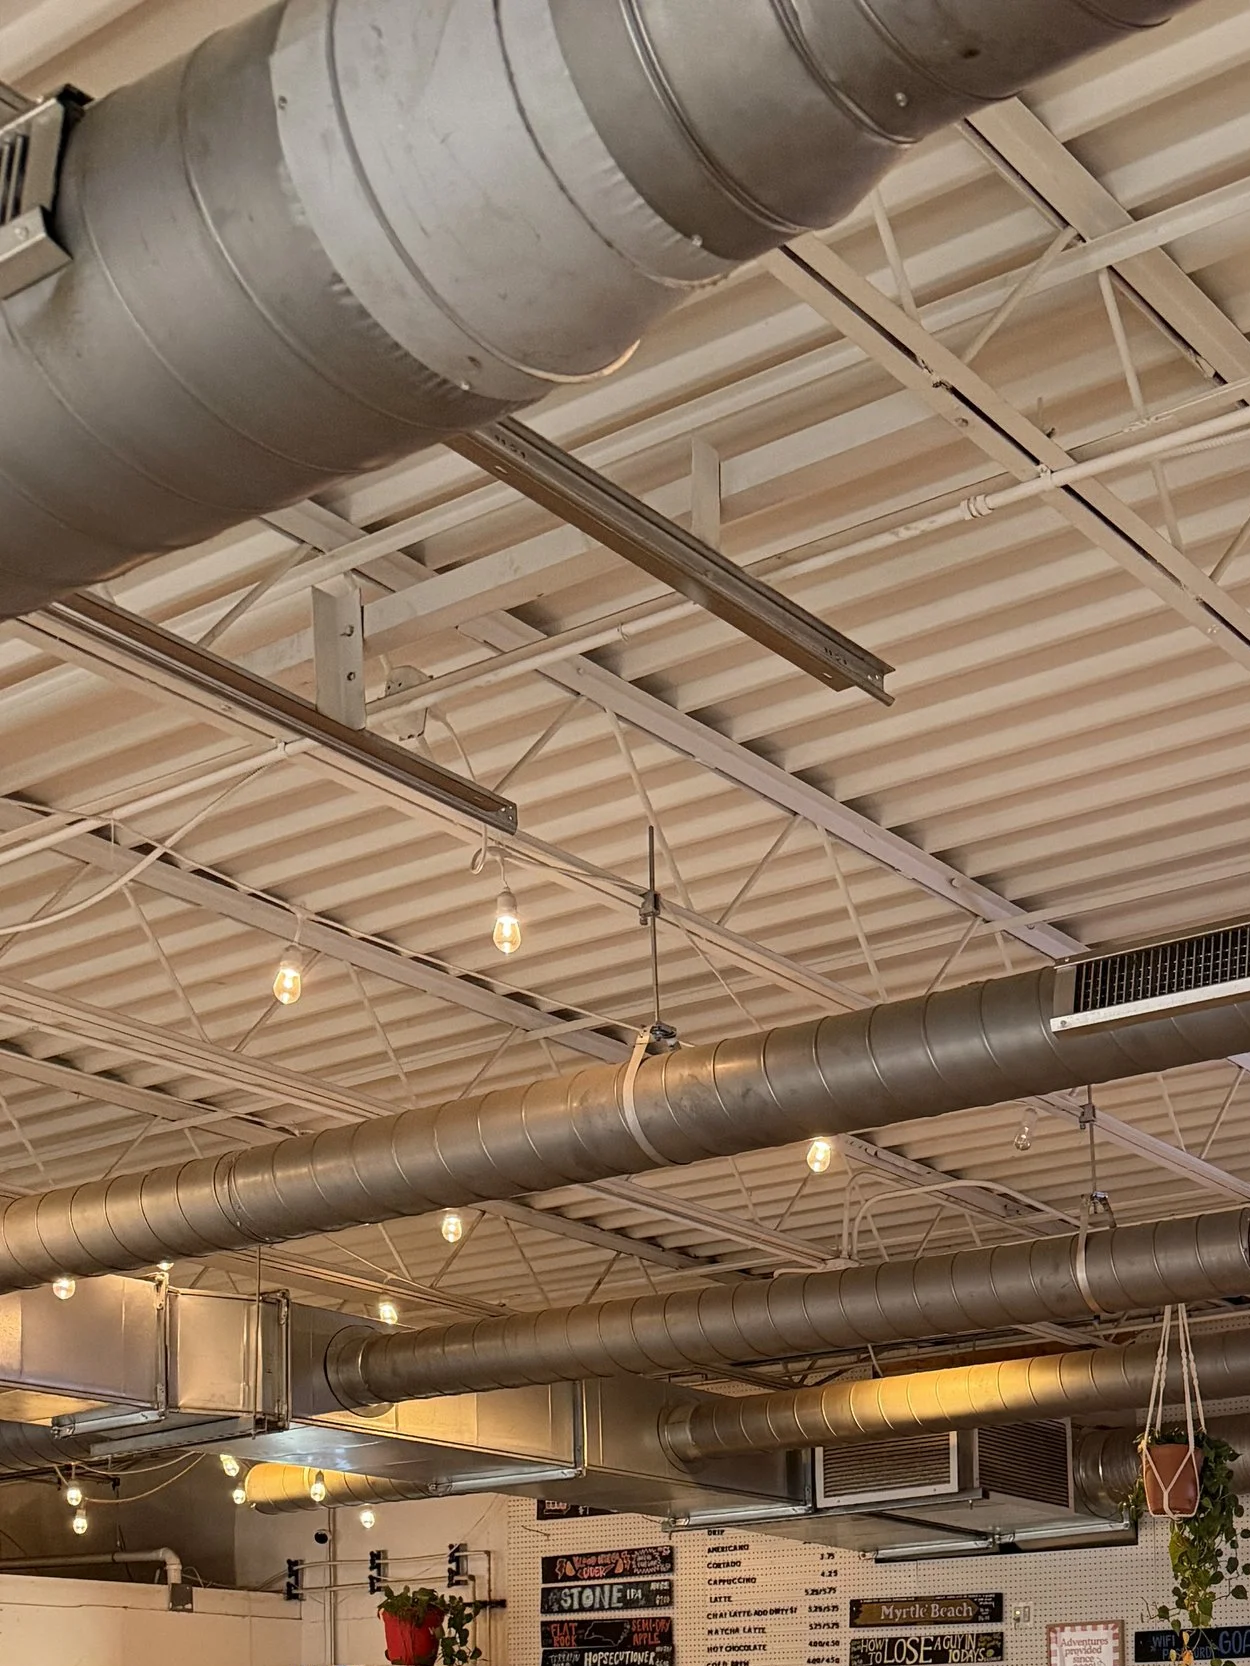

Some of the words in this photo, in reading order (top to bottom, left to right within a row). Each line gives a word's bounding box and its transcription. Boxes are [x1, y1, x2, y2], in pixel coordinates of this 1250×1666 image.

[707, 1544, 750, 1553] AMERICANO
[707, 1561, 742, 1569] CORTADO
[707, 1577, 757, 1585] CAPPUCCINO
[560, 1585, 623, 1610] STONE
[626, 1589, 642, 1600] IPA
[880, 1604, 928, 1622] Myrtle
[930, 1602, 973, 1618] Beach
[550, 1623, 578, 1636] FLAT
[707, 1627, 740, 1636] MATCHA
[553, 1636, 577, 1647] ROCK
[632, 1633, 660, 1646] APPLE
[1061, 1638, 1109, 1647] Adventures
[1152, 1634, 1175, 1648] WIFI
[707, 1645, 724, 1653] HOT
[725, 1644, 767, 1652] CHOCOLATE
[861, 1639, 884, 1653] HOW
[884, 1636, 934, 1665] LOSE
[934, 1638, 941, 1650] A
[943, 1635, 964, 1650] GUY
[965, 1634, 977, 1650] IN
[1065, 1646, 1102, 1657] provided
[584, 1651, 655, 1666] HOPSECUTIONER
[868, 1652, 883, 1666] TO
[1072, 1655, 1094, 1663] since
